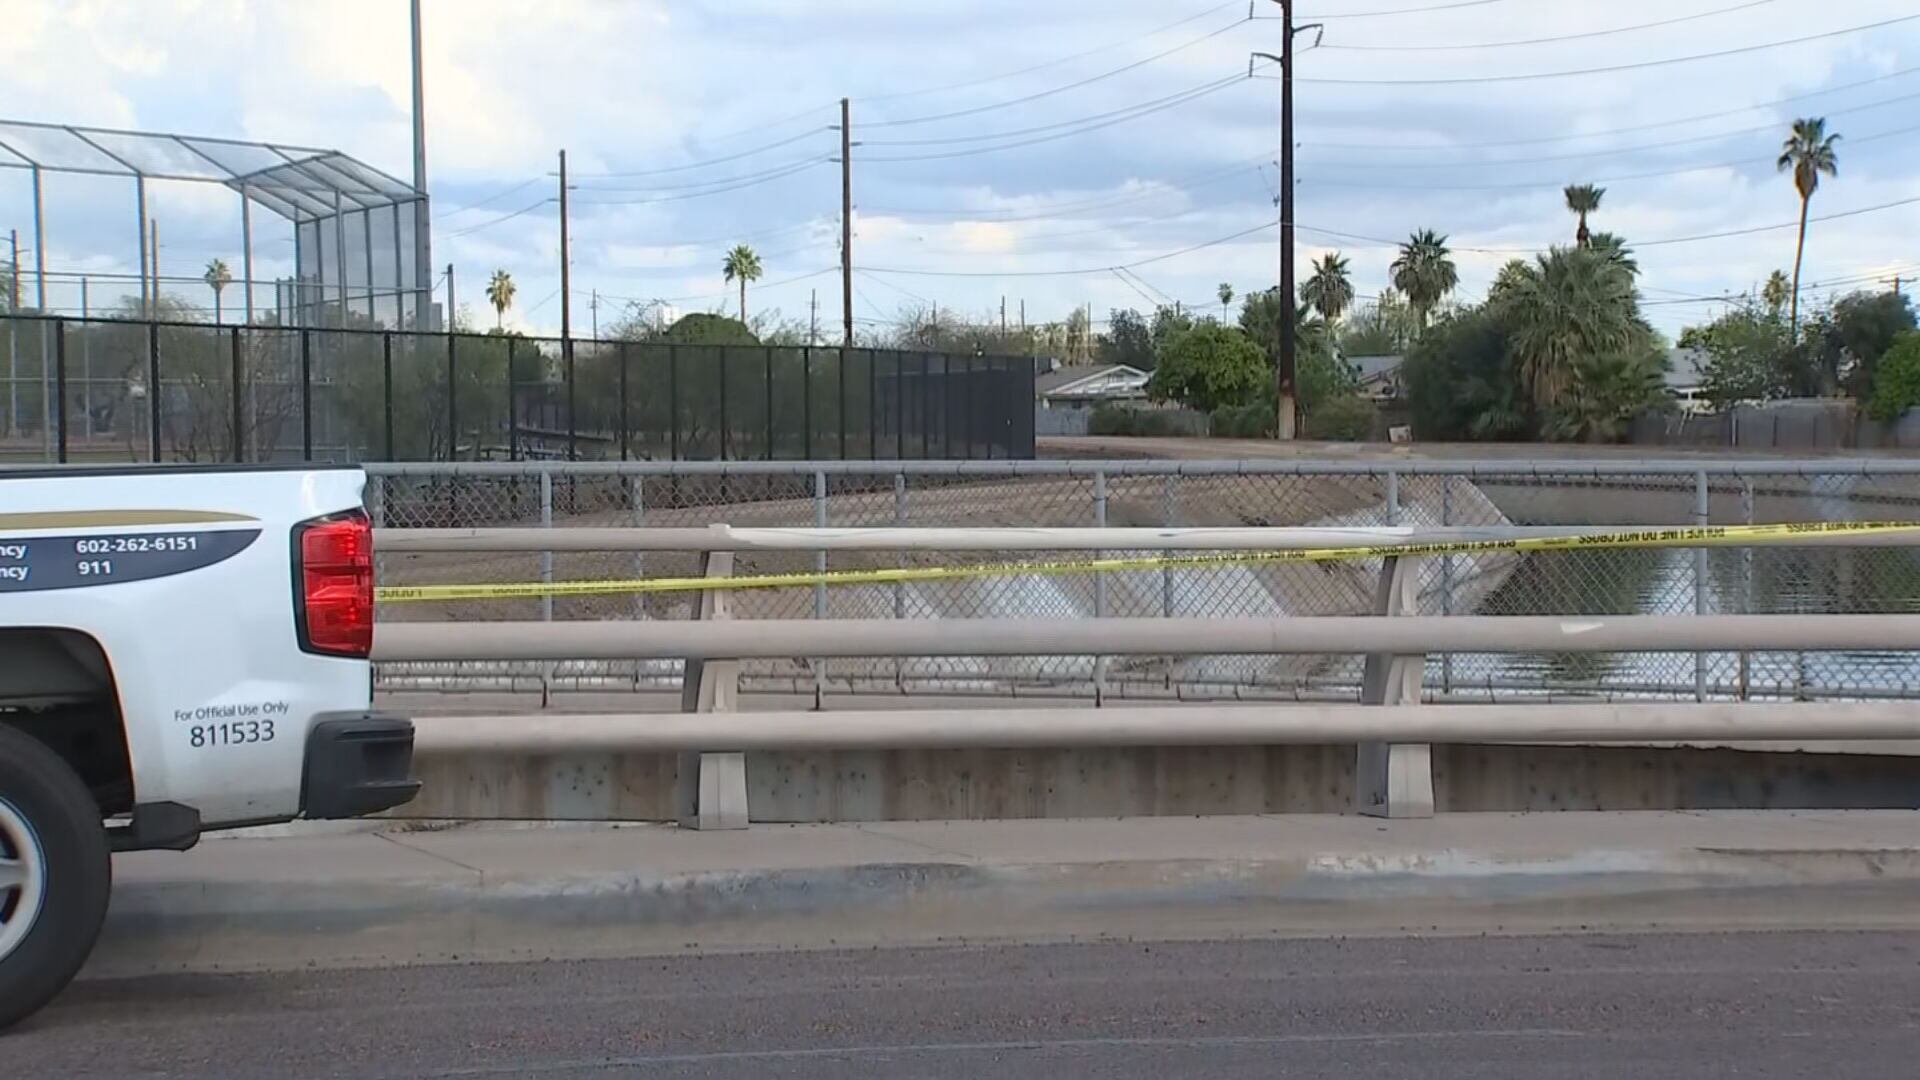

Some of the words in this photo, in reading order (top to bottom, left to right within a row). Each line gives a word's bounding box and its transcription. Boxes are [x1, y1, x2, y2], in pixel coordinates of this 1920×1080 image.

[76, 536, 198, 553] 602-262-6151
[78, 561, 111, 575] 911
[174, 709, 192, 721] For
[195, 705, 235, 721] Official
[238, 704, 258, 716] Use
[262, 700, 289, 715] Only
[190, 719, 275, 748] 811533
